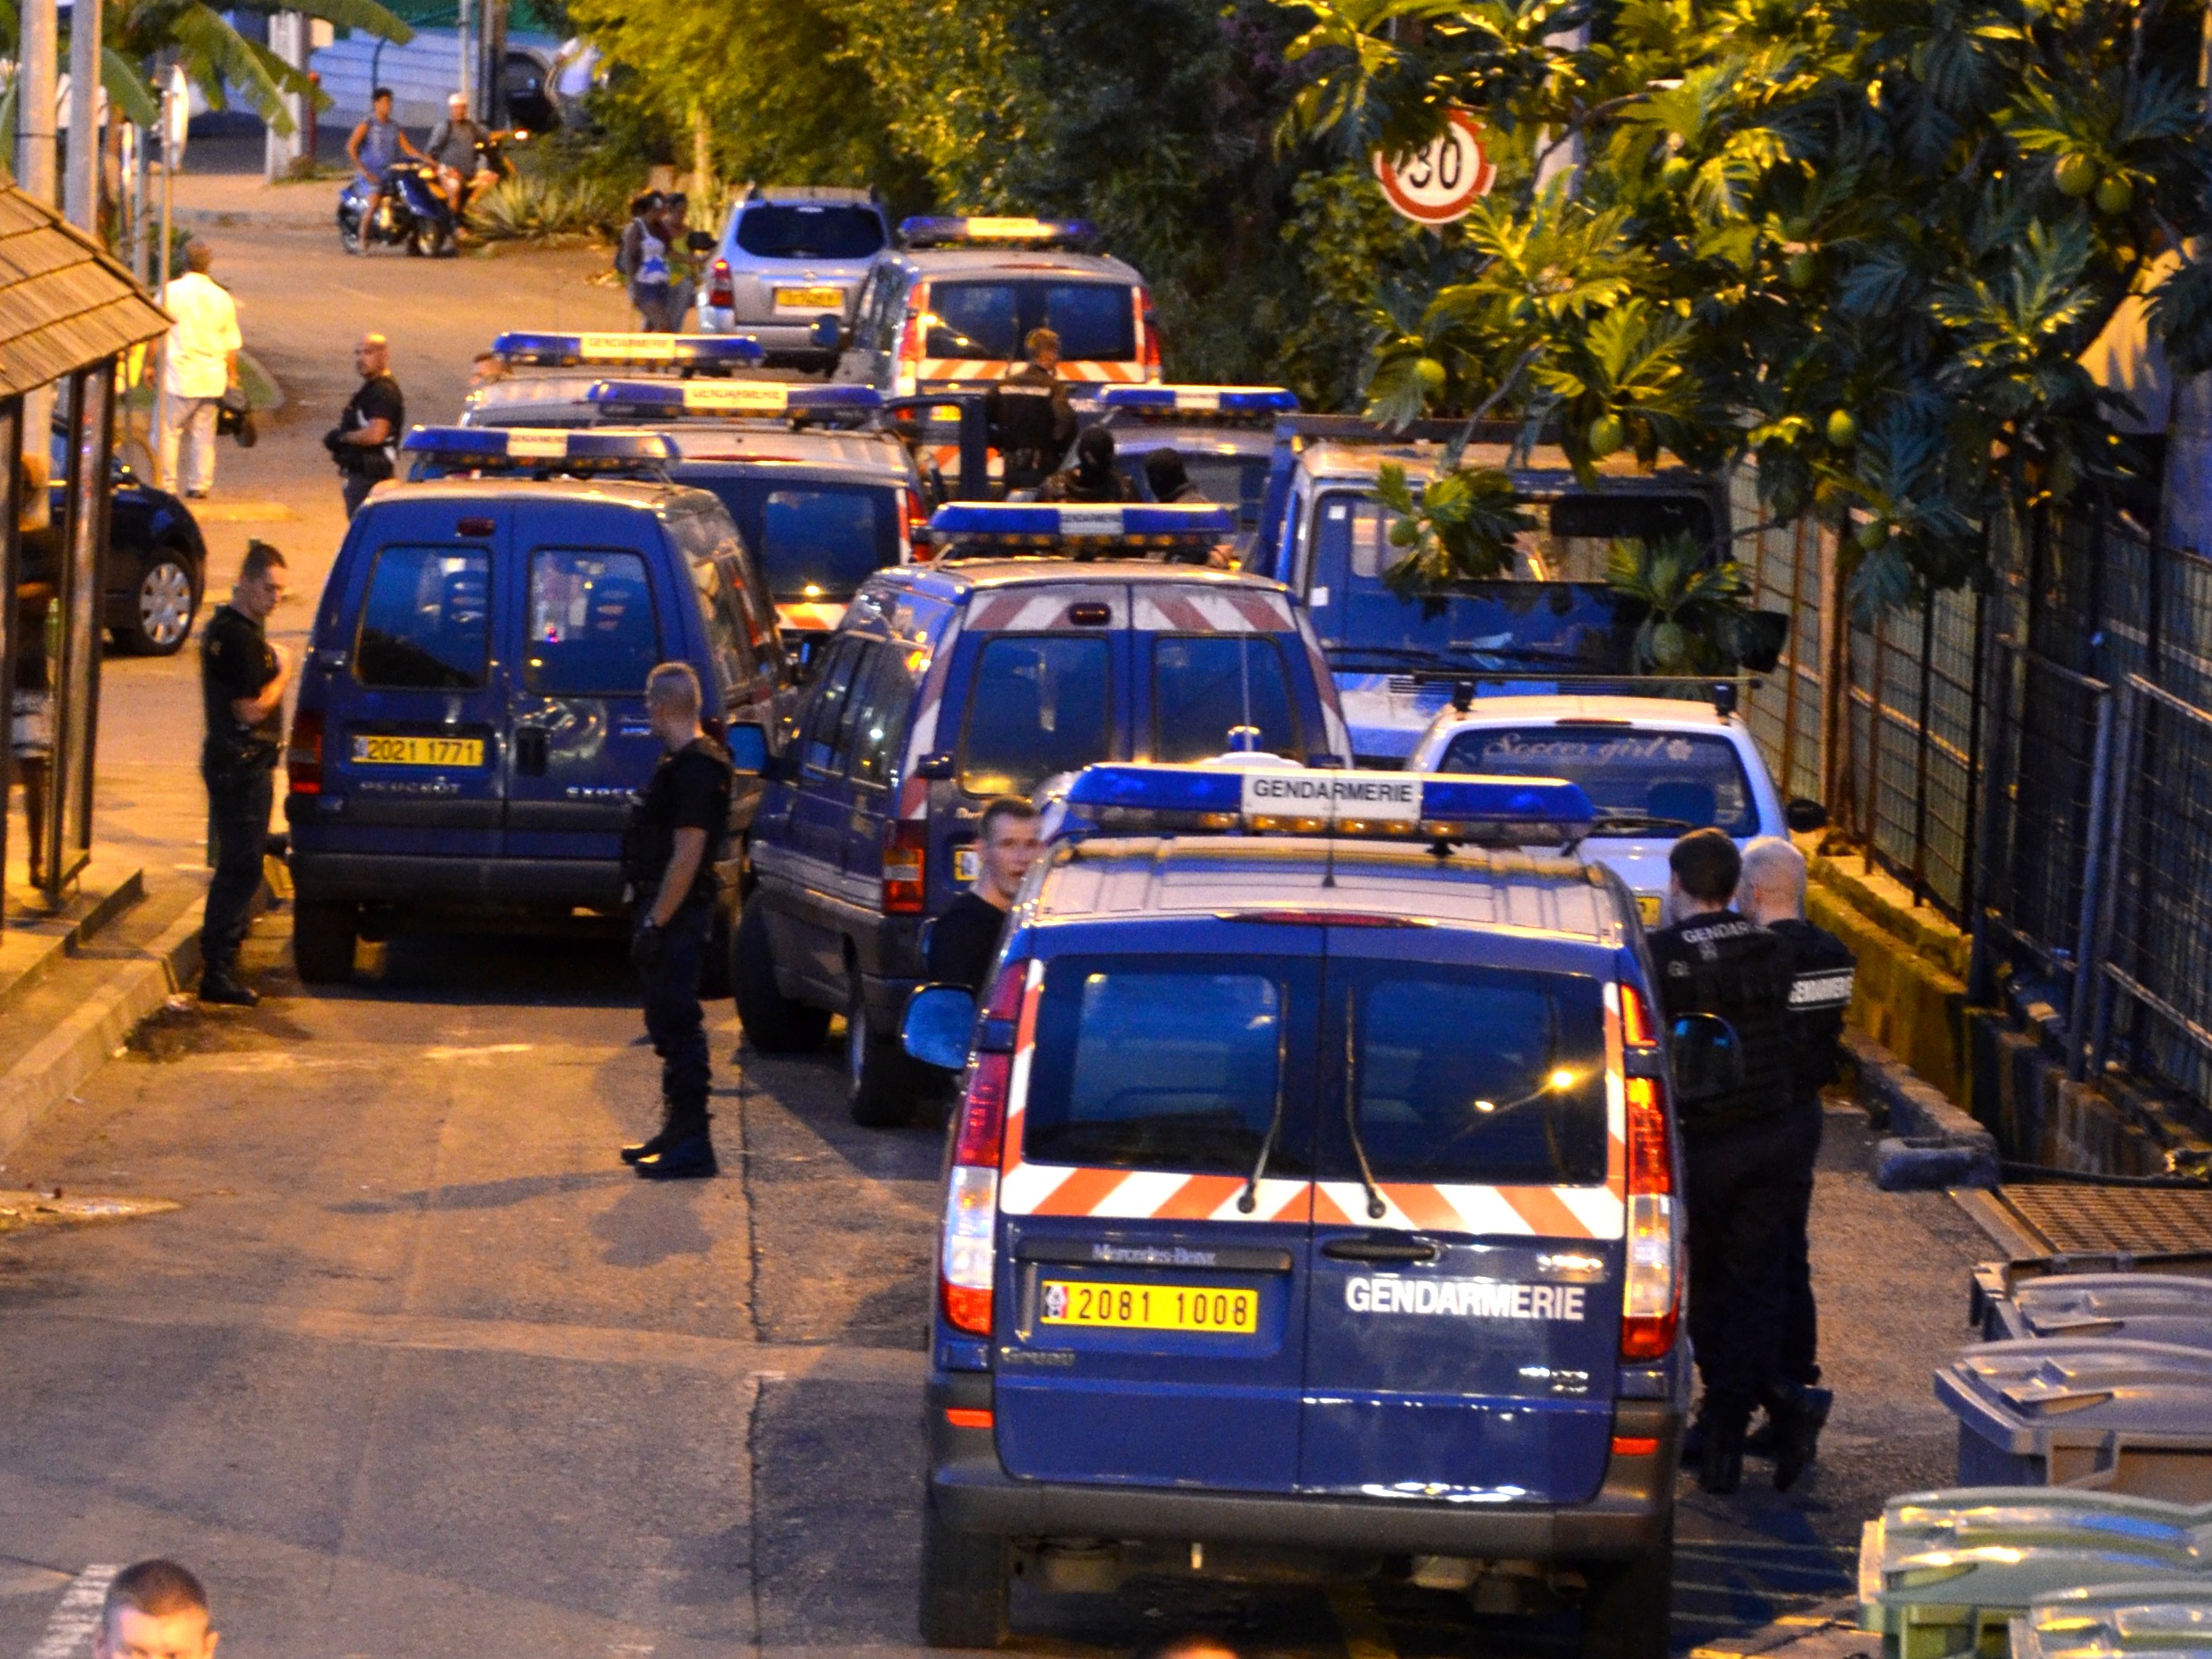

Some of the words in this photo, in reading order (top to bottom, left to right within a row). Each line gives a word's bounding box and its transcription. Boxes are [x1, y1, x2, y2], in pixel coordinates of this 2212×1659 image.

[1409, 140, 1461, 190] 30
[367, 739, 416, 761] 2021
[429, 741, 473, 763] 1771
[1254, 778, 1413, 802] GENDARMERIE
[1078, 1289, 1150, 1323] 2081
[1176, 1293, 1248, 1326] 1008
[1345, 1277, 1587, 1322] GENDARMERIE
